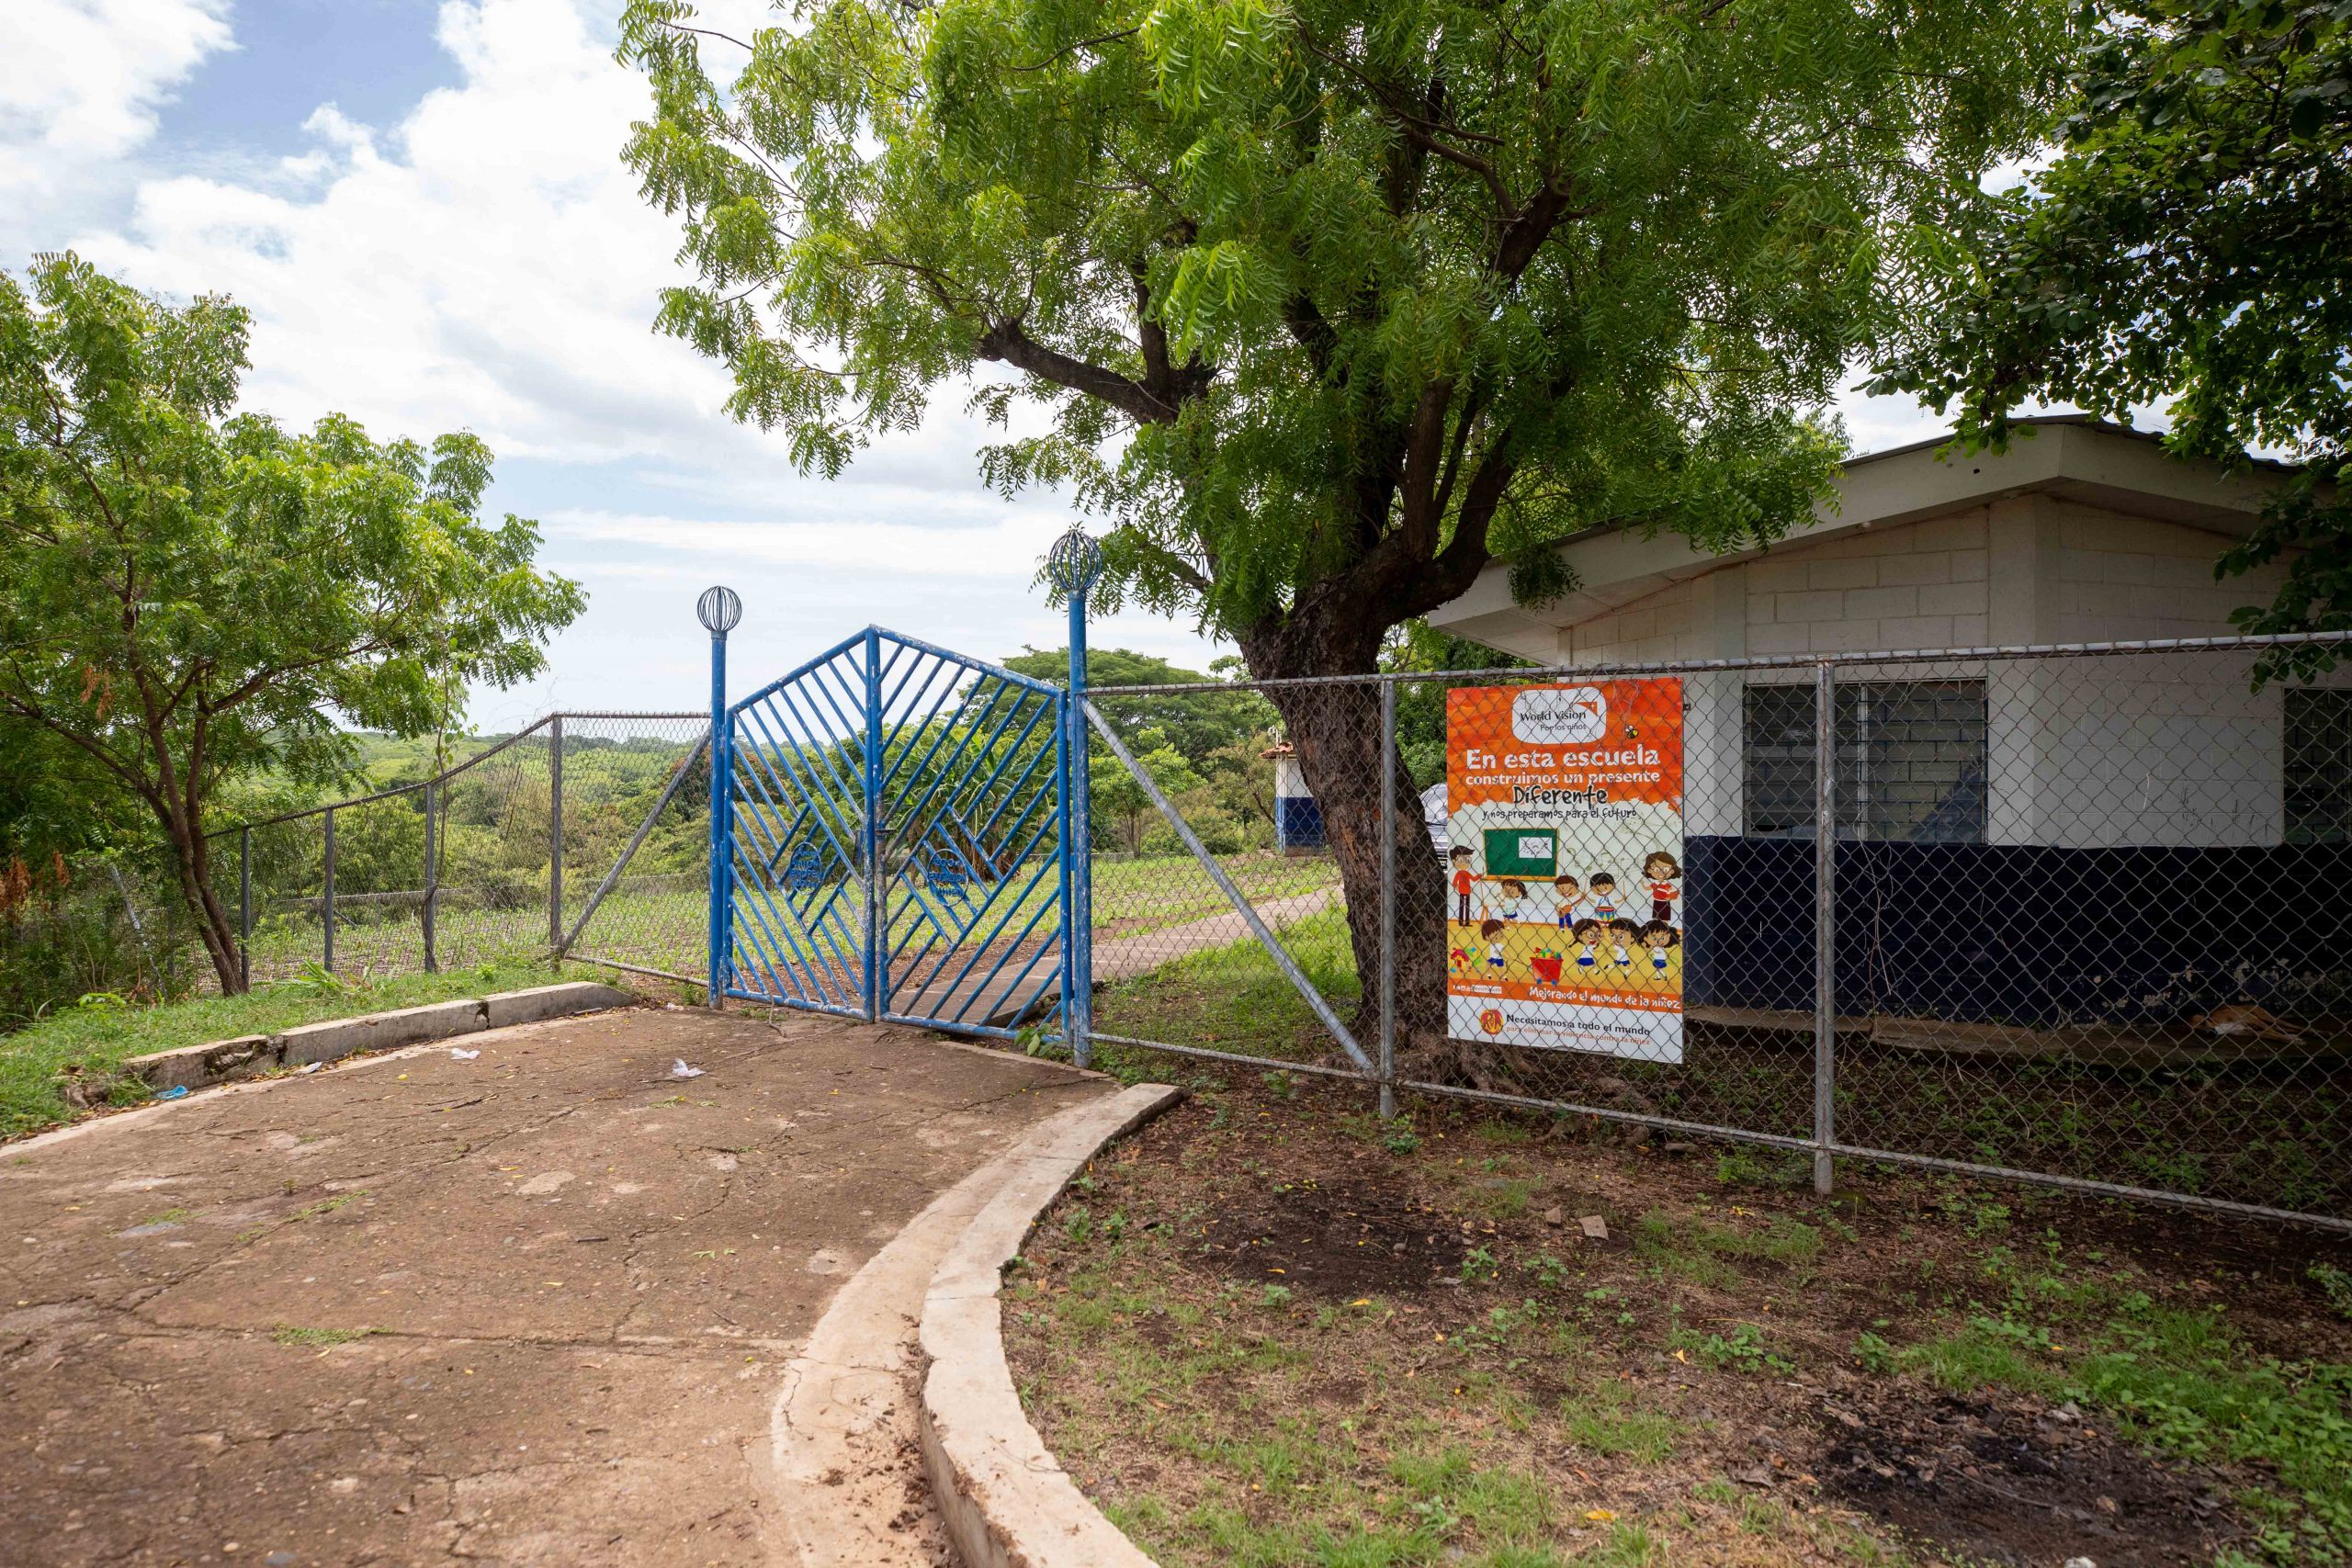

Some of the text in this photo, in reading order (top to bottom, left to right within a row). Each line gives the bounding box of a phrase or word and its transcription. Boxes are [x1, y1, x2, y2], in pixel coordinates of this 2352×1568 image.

[1521, 710, 1586, 721] World Vision
[1567, 723, 1587, 731] niños
[1466, 744, 1660, 770] En esta escuela
[1465, 771, 1660, 787] construimos un presente
[1513, 785, 1607, 809] Diferente
[1482, 807, 1637, 821] y nos preparamos para el futuro
[1530, 986, 1681, 1010] Mejorando el mundo de la niñez
[1507, 1014, 1566, 1028] Necesitamos
[1577, 1021, 1600, 1031] todo
[1603, 1023, 1611, 1032] el
[1615, 1026, 1650, 1036] mundo
[1523, 1027, 1553, 1035] elimnar
